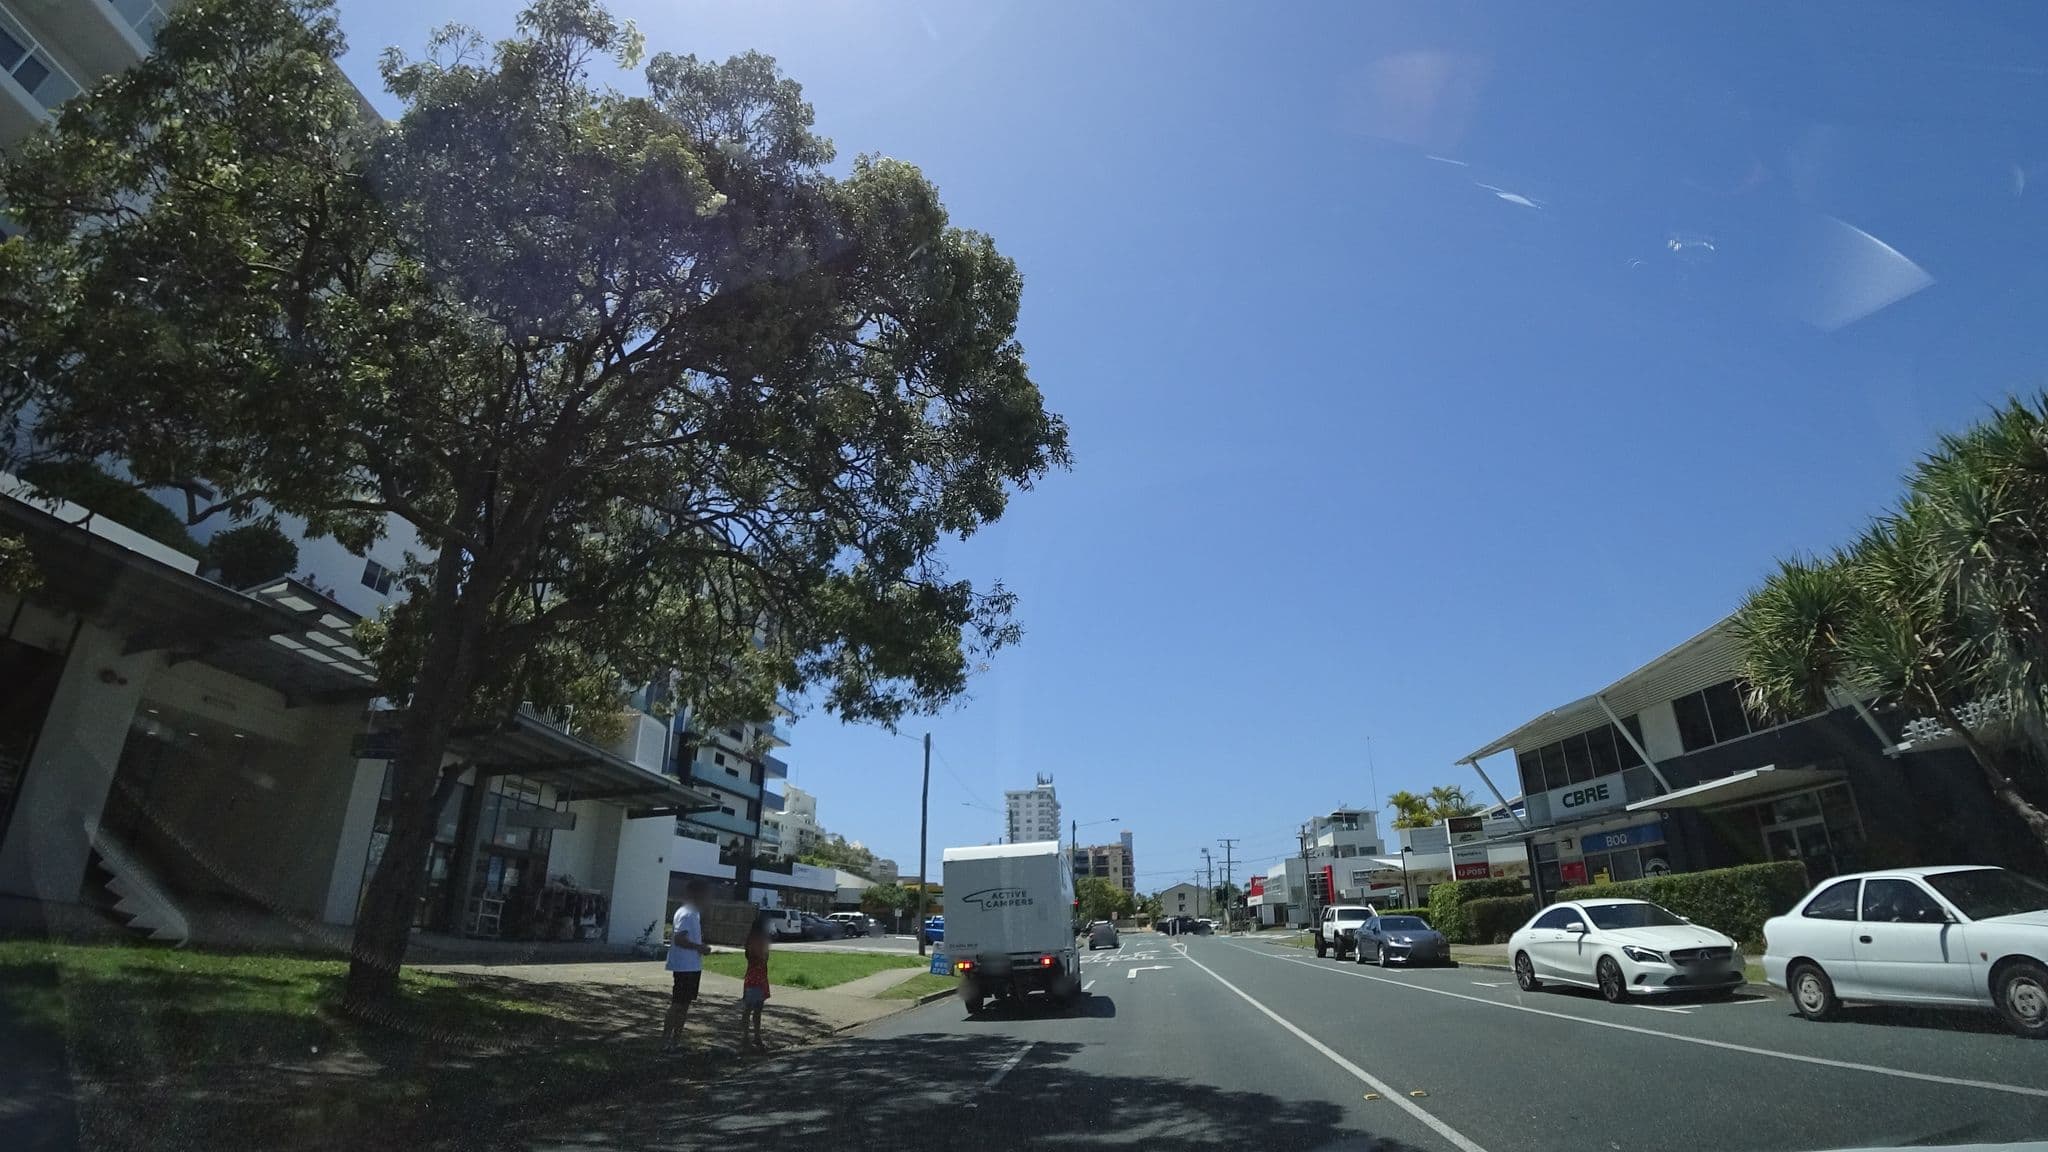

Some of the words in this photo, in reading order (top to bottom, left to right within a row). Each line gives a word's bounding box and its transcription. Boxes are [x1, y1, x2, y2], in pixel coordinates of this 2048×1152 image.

[1562, 783, 1610, 808] CBRE
[1606, 833, 1628, 847] BOQ
[1466, 867, 1487, 876] POST
[991, 890, 1027, 899] ACTIVE
[986, 898, 1034, 908] CAMPERS
